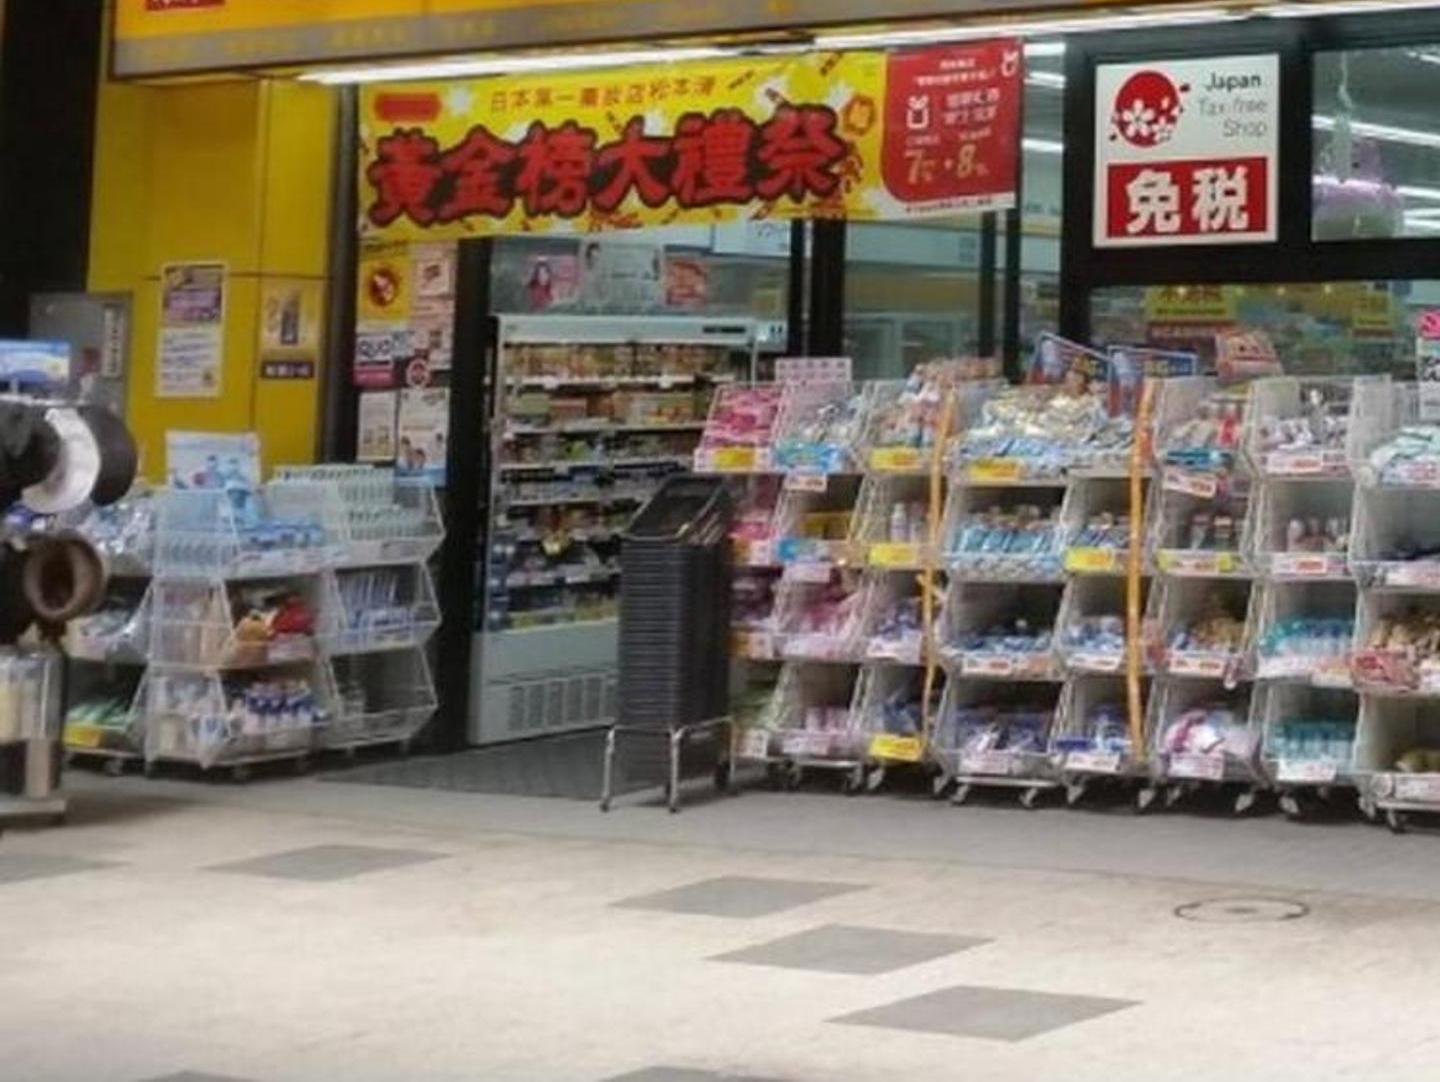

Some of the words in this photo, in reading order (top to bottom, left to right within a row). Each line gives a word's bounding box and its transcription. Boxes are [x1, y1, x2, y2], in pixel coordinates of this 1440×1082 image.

[1204, 72, 1262, 92] Japan
[1222, 120, 1268, 139] Shop
[1126, 165, 1250, 234] 免税
